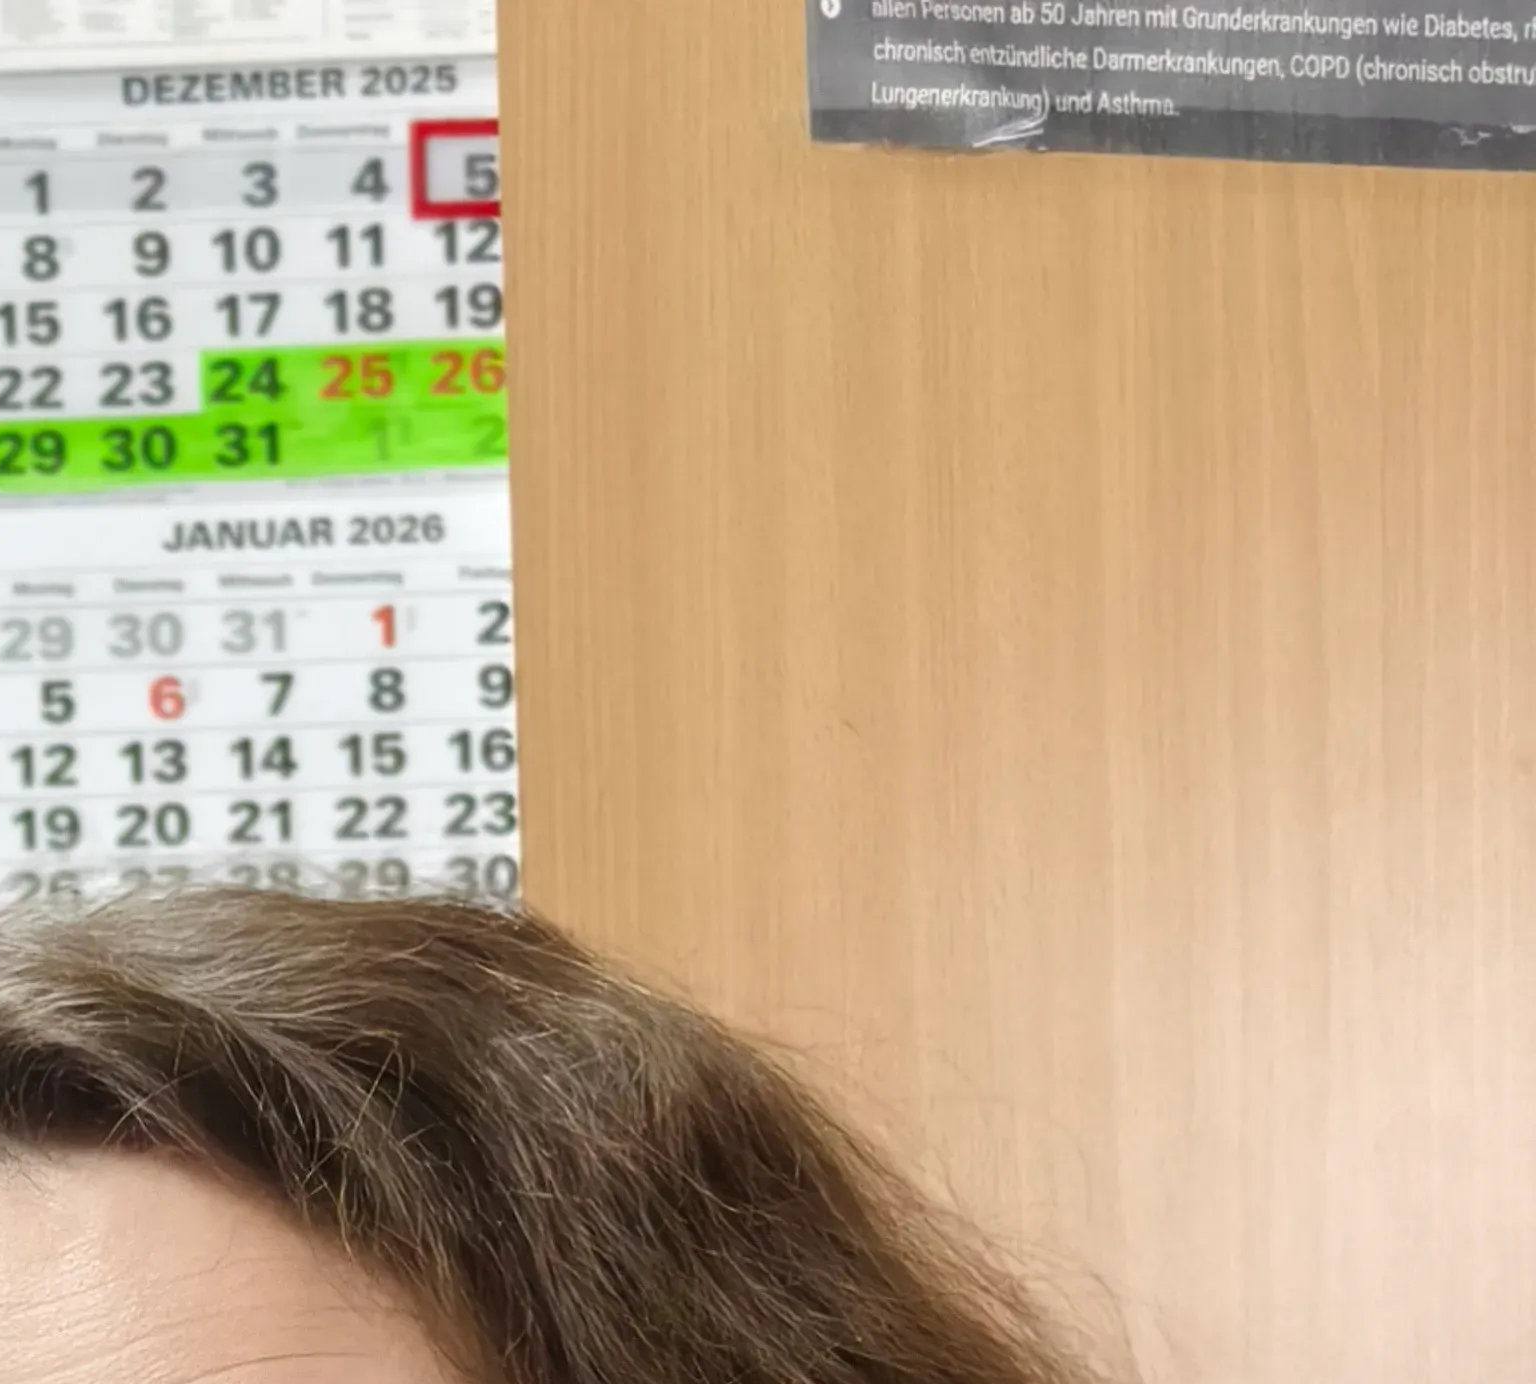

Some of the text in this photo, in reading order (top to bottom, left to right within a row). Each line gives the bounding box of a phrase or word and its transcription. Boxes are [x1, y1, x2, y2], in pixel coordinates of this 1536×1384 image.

[871, 0, 916, 18] allen
[922, 0, 1004, 24] Personen
[1010, 2, 1035, 25] ab
[1040, 3, 1065, 25] 50
[1071, 4, 1140, 28] Jahren
[1145, 6, 1177, 28] mit
[1182, 6, 1378, 40] Grunderkrankungen
[1383, 13, 1419, 36] wie
[1424, 10, 1518, 43] Diabetes,
[121, 63, 459, 106] DEZEMBER 2025
[873, 36, 965, 64] chronisch
[969, 44, 1087, 70] entzündliche
[1093, 46, 1285, 80] Darmerkrankungen,
[1290, 55, 1350, 79] COPD
[1355, 54, 1463, 86] (chronisch
[871, 81, 1180, 118] Lungenerkrankung) und Asthma.
[25, 170, 49, 216] 1
[132, 166, 167, 212] 2
[242, 161, 278, 208] 3
[351, 157, 391, 203] 4
[464, 153, 499, 198] 5
[22, 234, 59, 282] 8
[133, 230, 170, 278] 9
[212, 227, 281, 273] 10
[326, 223, 384, 269] 11
[435, 219, 500, 265] 12
[104, 296, 173, 343] 16
[216, 292, 282, 338] 17
[324, 287, 394, 334] 18
[434, 283, 503, 329] 19
[99, 361, 175, 407] 23
[209, 358, 285, 404] 24
[319, 353, 394, 400] 25
[430, 349, 505, 396] 26
[100, 425, 177, 473] 30
[216, 422, 279, 468] 31
[162, 511, 445, 554] JANUAR 2026
[109, 612, 184, 658] 30
[221, 609, 287, 654] 31
[372, 605, 396, 649] 1
[477, 600, 511, 645] 2
[40, 679, 76, 724] 5
[148, 675, 186, 721] 6
[261, 671, 295, 716] 7
[369, 667, 406, 713] 8
[478, 663, 514, 709] 9
[12, 743, 78, 788] 12
[121, 739, 188, 785] 13
[229, 735, 298, 781] 14
[339, 732, 406, 777] 15
[448, 727, 516, 773] 16
[13, 805, 81, 851] 19
[116, 802, 190, 847] 20
[227, 799, 292, 844] 21
[334, 795, 408, 840] 22
[444, 791, 516, 837] 23
[447, 854, 518, 900] 30
